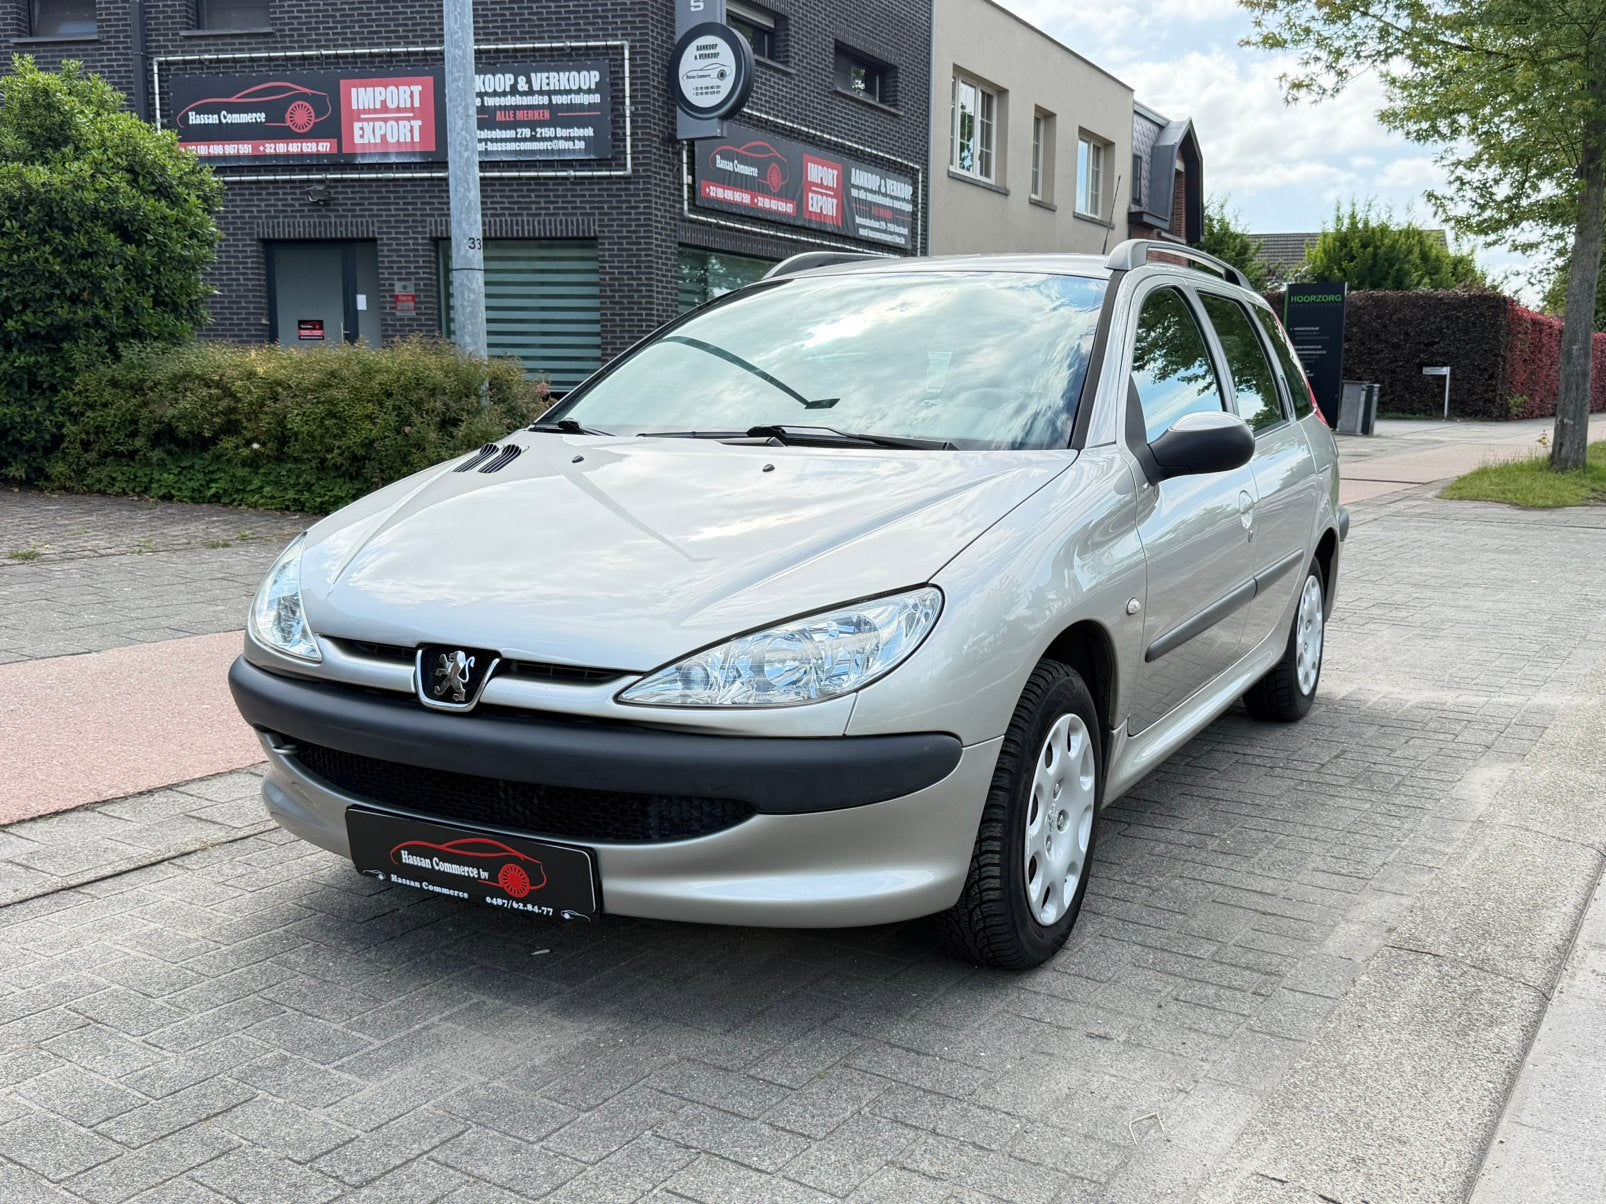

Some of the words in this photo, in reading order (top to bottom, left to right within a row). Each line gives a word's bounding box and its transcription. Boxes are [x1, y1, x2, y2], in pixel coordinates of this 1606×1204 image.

[475, 73, 514, 93] KOOP
[517, 75, 529, 92] &
[530, 70, 600, 91] VERKOOP
[351, 85, 422, 110] IMPORT
[484, 93, 549, 107] tweedehandse
[551, 92, 601, 105] voertuigen
[188, 111, 219, 125] Hassan
[220, 110, 266, 124] Commerce
[496, 110, 515, 122] ALLE
[516, 109, 551, 122] MERKEN
[353, 120, 422, 144] EXPORT
[516, 127, 531, 138] 279
[536, 126, 555, 138] 2150
[808, 162, 838, 188] IMPORT
[808, 192, 838, 217] EXPORT
[1290, 294, 1342, 303] HOORZORG
[401, 850, 432, 869] Hassan
[432, 856, 479, 879] Commerce
[390, 873, 421, 888] Hassan
[422, 881, 469, 899] Commerce
[485, 896, 554, 916] 0487/62.84.77
